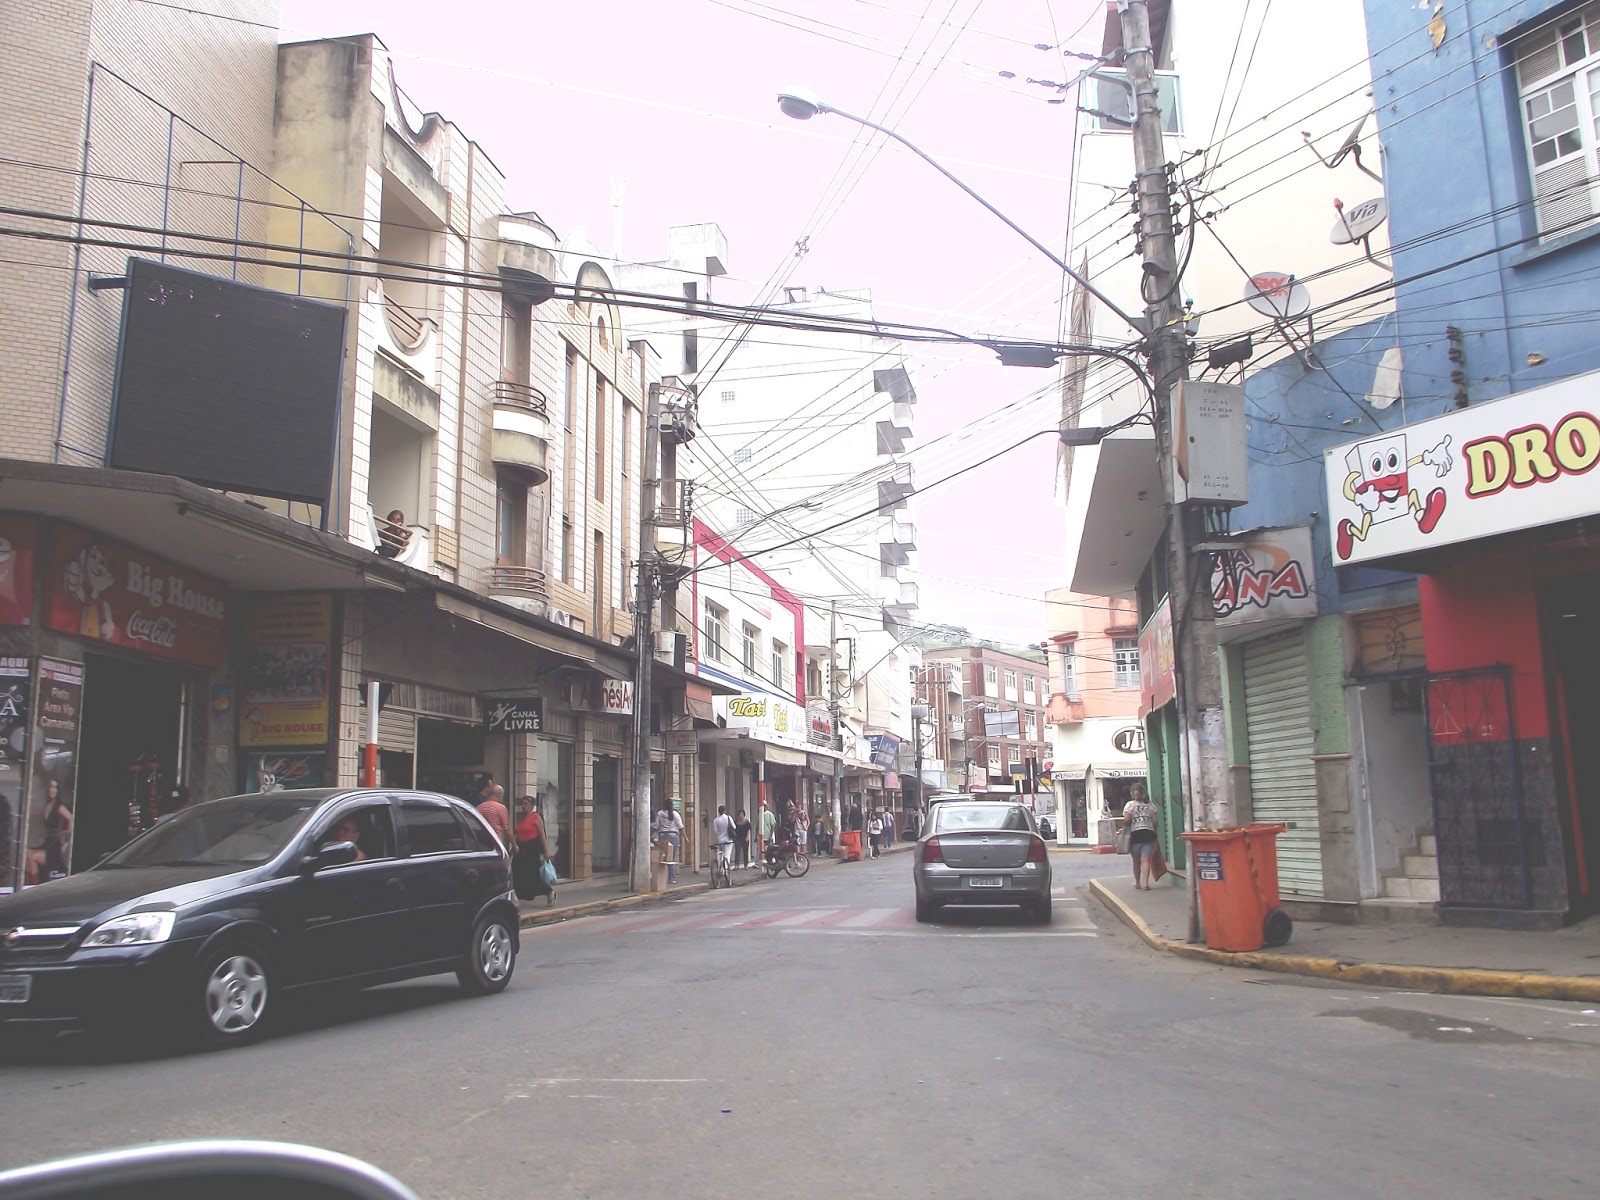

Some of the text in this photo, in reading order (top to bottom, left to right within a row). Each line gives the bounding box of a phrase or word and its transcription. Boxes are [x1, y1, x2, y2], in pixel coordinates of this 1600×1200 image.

[1350, 203, 1379, 223] Via
[1462, 412, 1600, 499] DRO
[127, 560, 225, 620] Big House
[511, 711, 538, 720] CANAL
[729, 697, 768, 718] Tati
[503, 719, 540, 732] LIVRE
